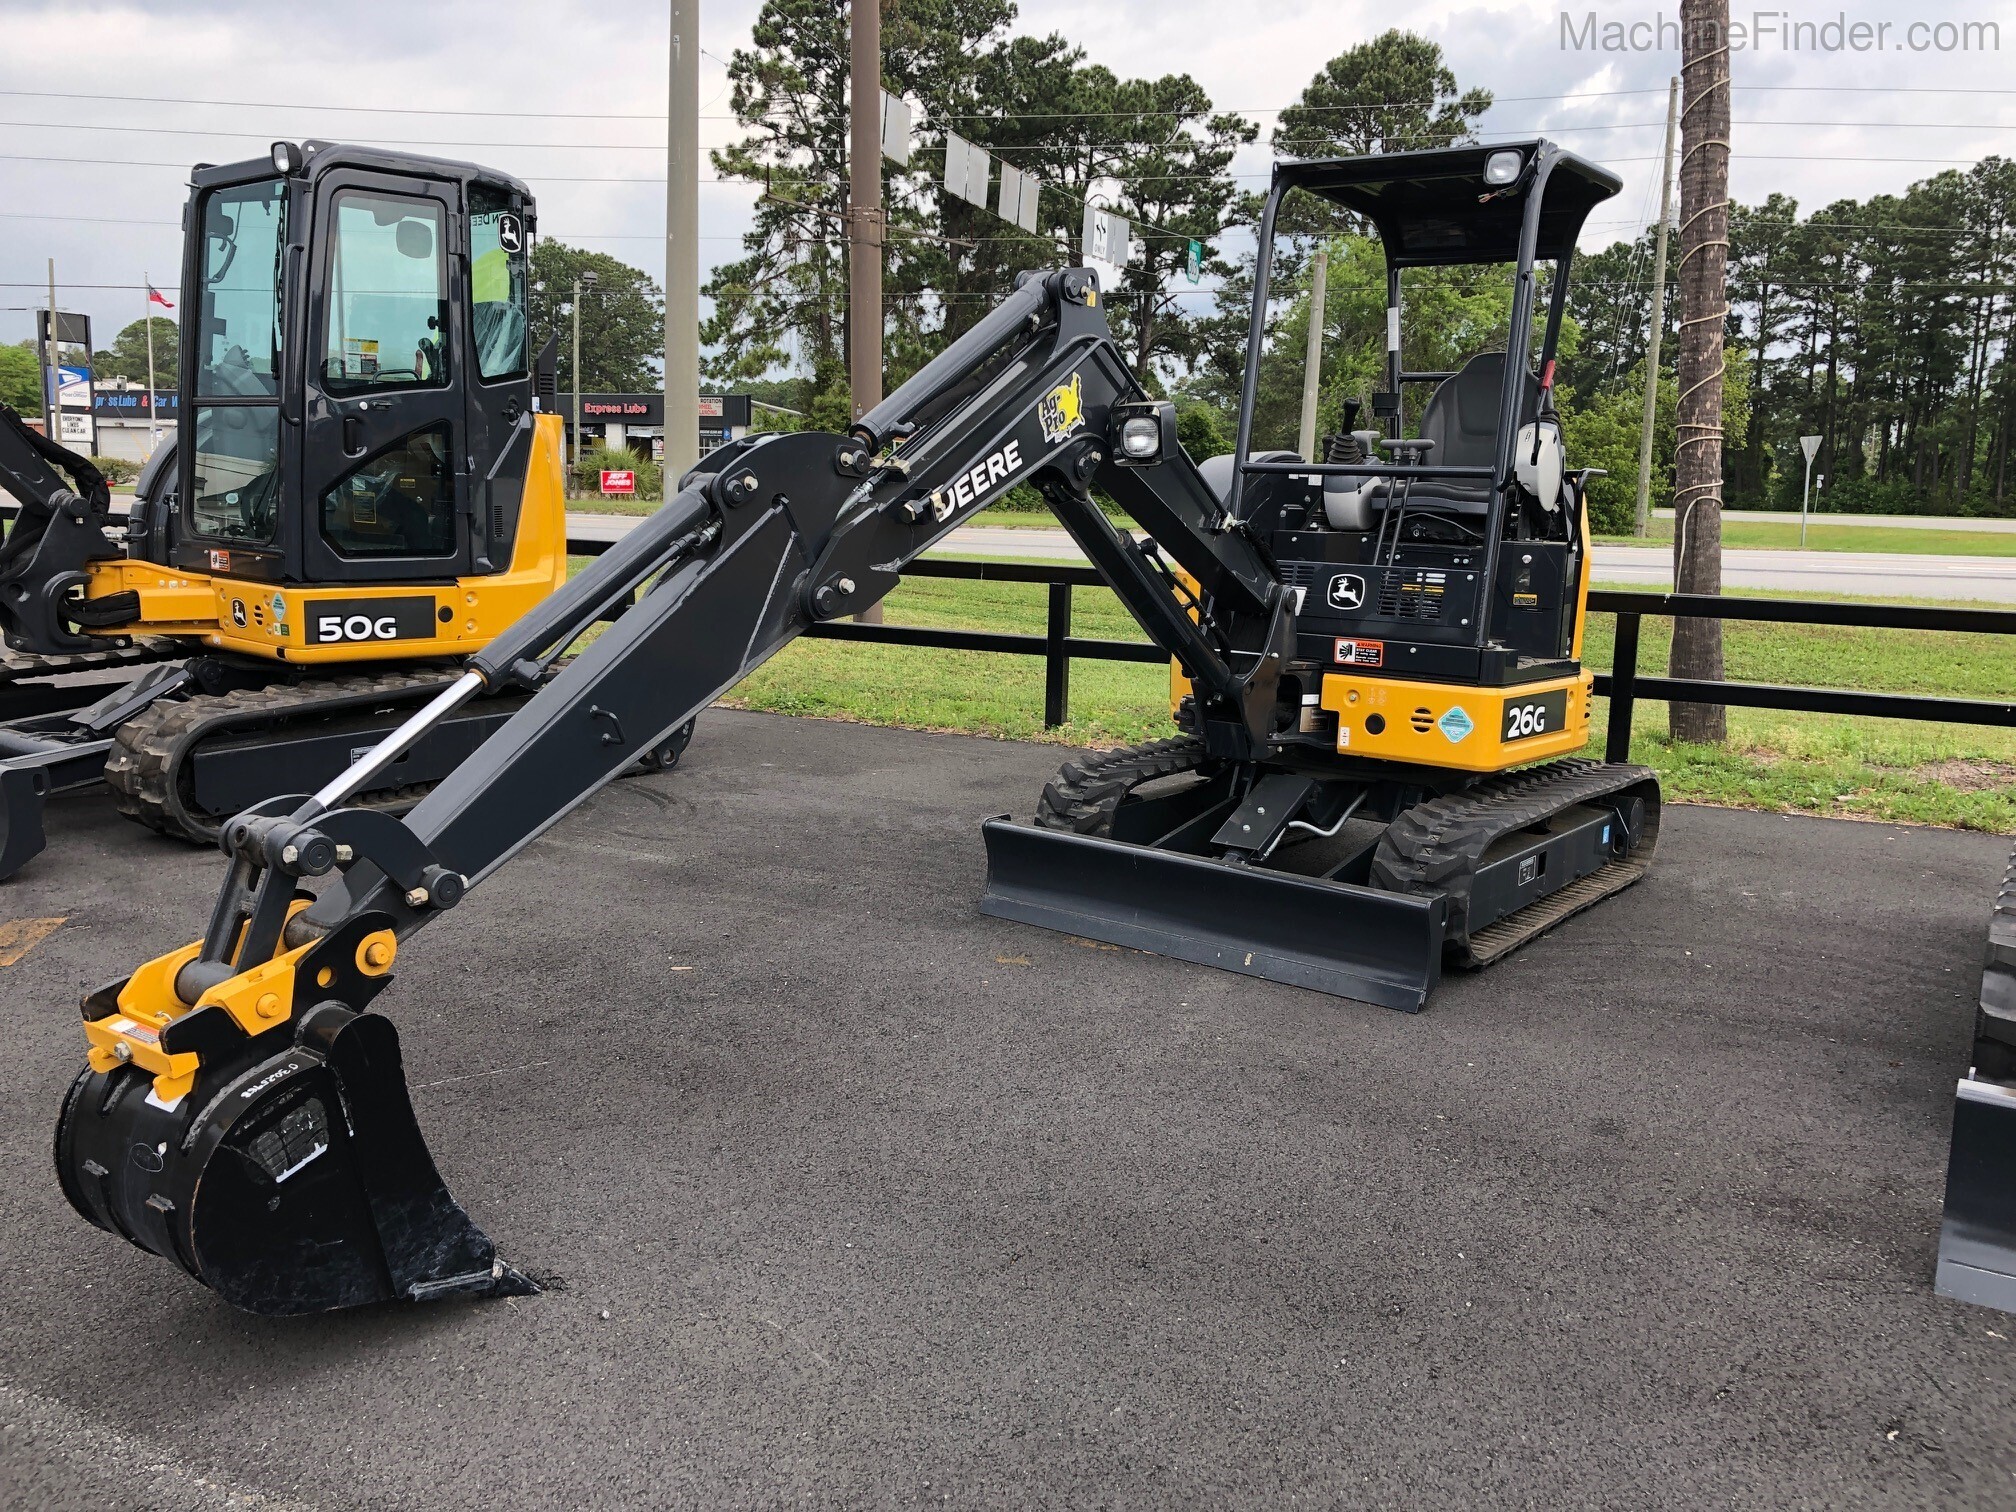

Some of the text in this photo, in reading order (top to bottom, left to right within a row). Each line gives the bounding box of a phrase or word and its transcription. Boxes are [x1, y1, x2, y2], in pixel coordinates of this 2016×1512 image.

[1094, 243, 1107, 256] ONLY
[118, 395, 137, 407] Lube
[141, 395, 149, 407] &
[154, 395, 167, 407] Car
[584, 402, 647, 415] Express Lube
[1044, 411, 1065, 436] Pro
[608, 472, 627, 480] JEFF
[932, 439, 1023, 523] DEERE
[318, 615, 397, 642] 50G
[1507, 704, 1546, 739] 26G
